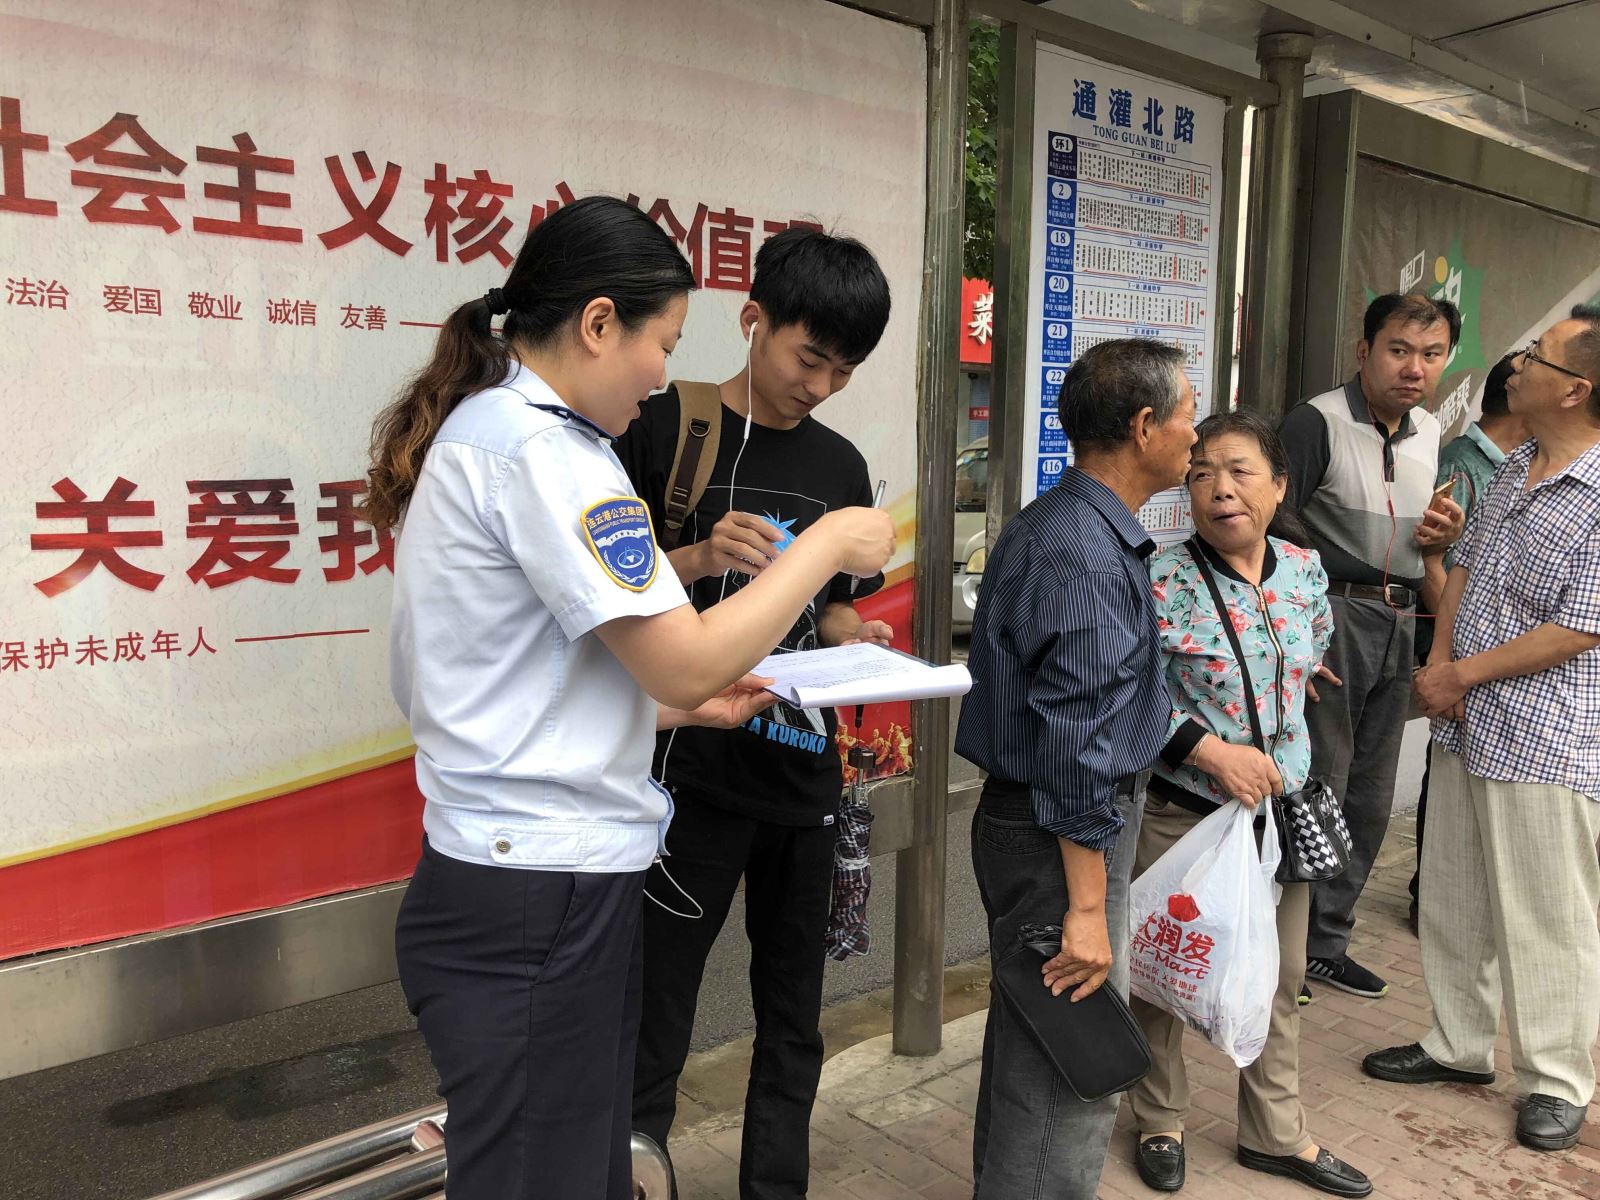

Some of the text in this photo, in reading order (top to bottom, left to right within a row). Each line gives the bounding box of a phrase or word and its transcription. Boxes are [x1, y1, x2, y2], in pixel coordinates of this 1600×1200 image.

[1072, 79, 1195, 144] 通灌北路
[1055, 138, 1069, 151] 环1
[1093, 124, 1177, 154] TONG GUAN BEI LU
[1058, 184, 1064, 196] 2
[1055, 231, 1066, 244] 18
[1053, 277, 1065, 290] 20
[5, 277, 388, 332] 法治 爱国 敬业 诚信 友善
[1052, 324, 1062, 336] 21
[1051, 371, 1062, 382] 22
[1049, 416, 1060, 427] 27
[1044, 461, 1060, 472] 116
[0, 626, 217, 673] 保护未成年人
[766, 721, 827, 755] KUROKO
[1138, 912, 1215, 964] 大润发
[1130, 936, 1209, 980] RT-Mart
